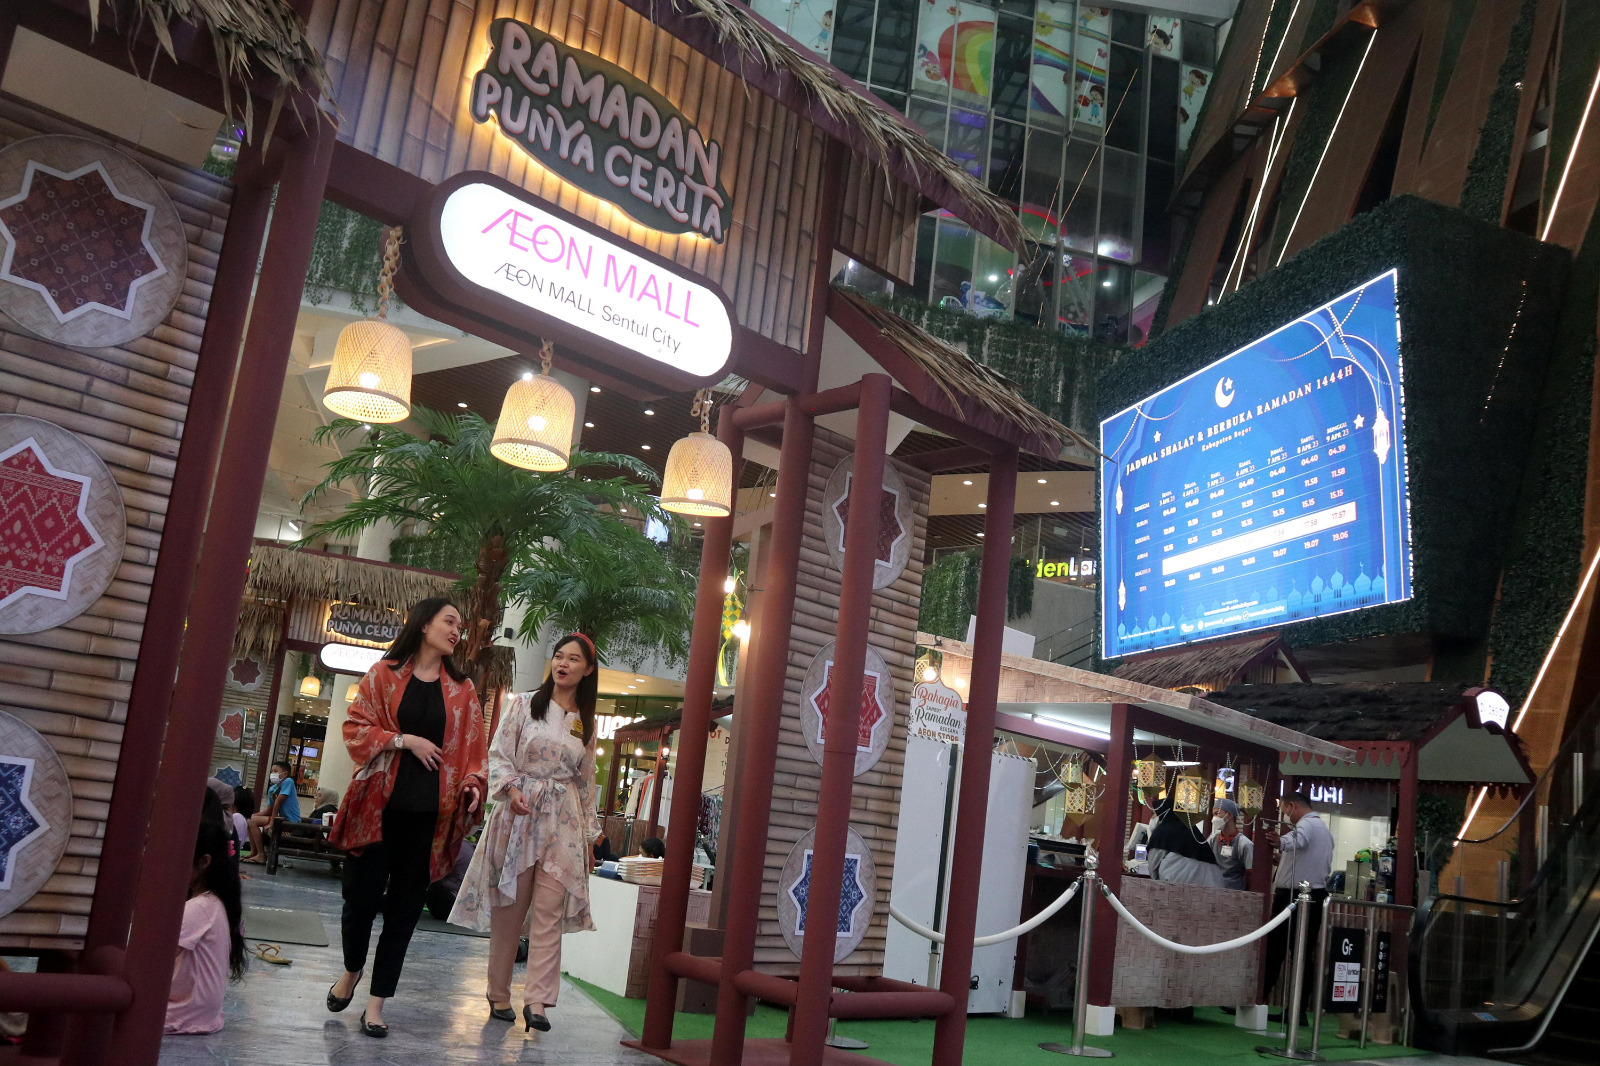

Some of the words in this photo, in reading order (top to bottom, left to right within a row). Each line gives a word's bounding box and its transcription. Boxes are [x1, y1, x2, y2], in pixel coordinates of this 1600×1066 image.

[498, 21, 722, 188] RAMADAN
[475, 72, 594, 173] PUNYA
[604, 145, 724, 241] CERITA
[603, 253, 700, 328] MALL
[548, 281, 596, 317] MALL
[601, 305, 649, 339] Sentul
[652, 327, 682, 354] City
[1126, 452, 1158, 476] JADWAL
[1160, 435, 1195, 459] SHALAT
[1197, 431, 1204, 442] &
[1207, 410, 1253, 438] BERBUKA
[1256, 382, 1313, 416] RAMADAN
[1316, 364, 1354, 390] 1444H
[1302, 444, 1312, 452] APR
[1331, 432, 1342, 441] APR
[1301, 454, 1319, 466] 04.40
[1328, 444, 1347, 456] 04.39
[328, 619, 362, 635] PUNYA
[917, 686, 959, 711] Bahagia
[914, 706, 961, 730] Ramadan
[917, 727, 937, 738] AEON
